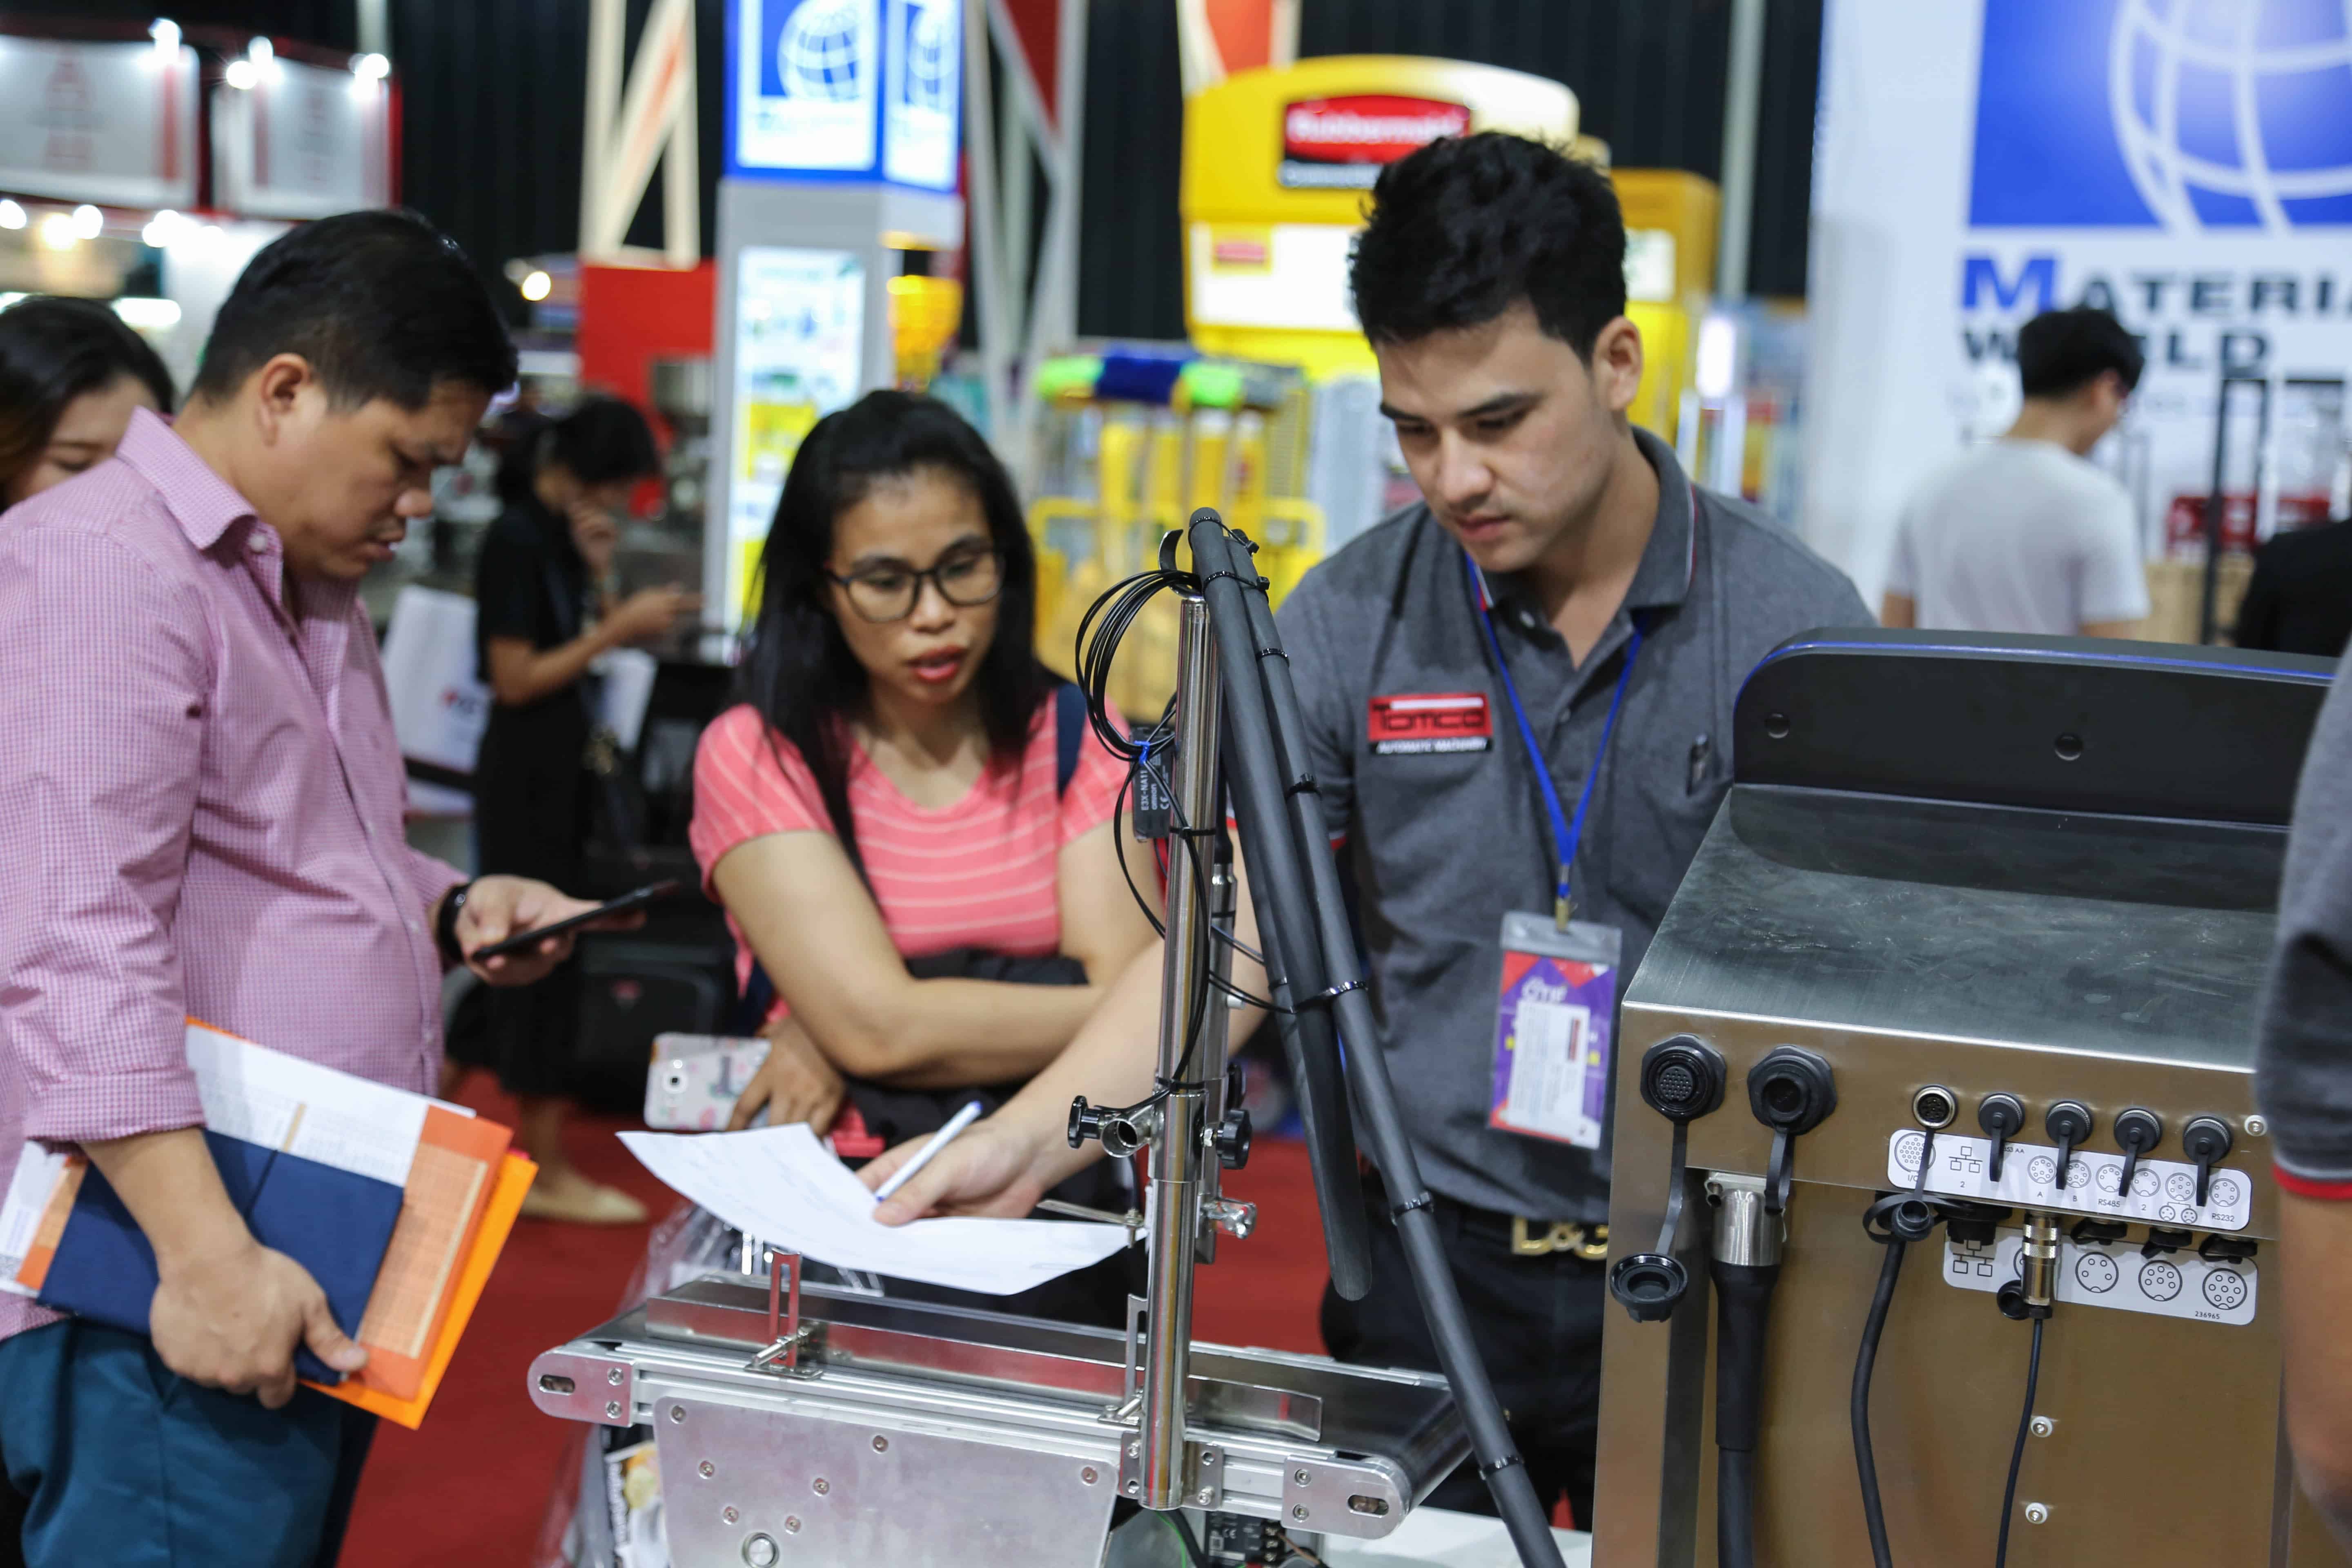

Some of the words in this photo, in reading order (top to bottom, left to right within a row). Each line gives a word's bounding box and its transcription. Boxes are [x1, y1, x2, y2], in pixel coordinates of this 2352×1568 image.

[1962, 256, 2352, 318] MATERI
[1962, 329, 2270, 376] WLD
[2098, 1198, 2120, 1207] RS485
[2212, 1213, 2235, 1222] RS232
[2195, 1311, 2220, 1319] 236965
